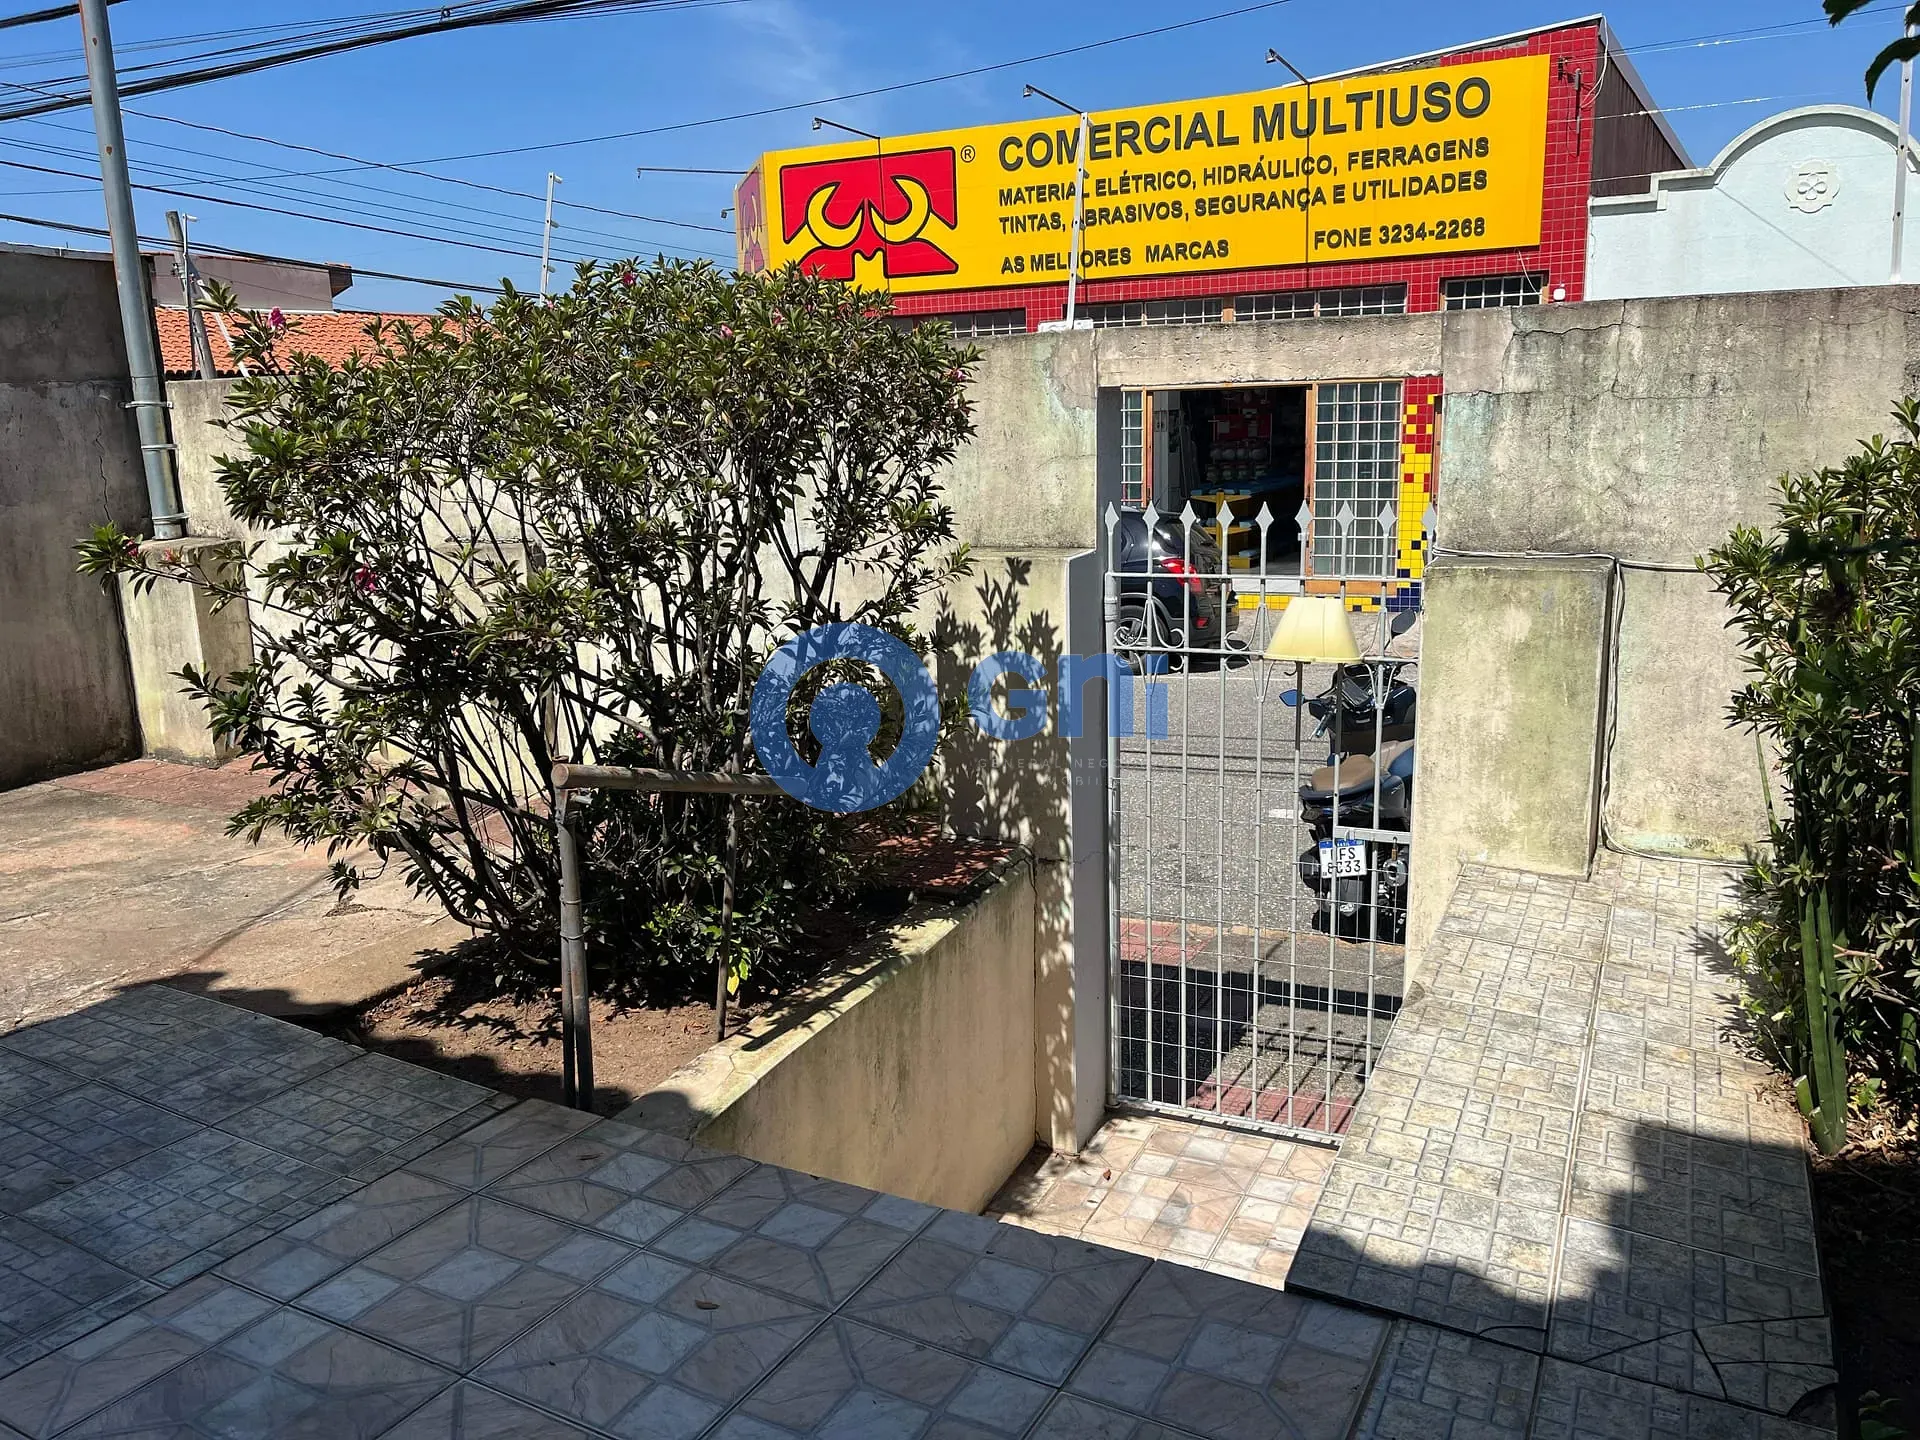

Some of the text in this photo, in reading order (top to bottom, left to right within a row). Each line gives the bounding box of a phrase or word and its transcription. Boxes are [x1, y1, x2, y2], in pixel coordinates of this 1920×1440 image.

[999, 77, 1491, 172] COMERCIAL MULTIUSO
[1095, 169, 1196, 197] ELÉTRICO,
[1203, 154, 1338, 187] HIDRÁULICO,
[1347, 137, 1489, 172] FERRAGENS
[999, 169, 1488, 234] TINTAS, BRASIVOS, SEGURANÇA E UTILIDADES
[1001, 256, 1025, 274] AS
[1145, 239, 1230, 263] MARCAS
[1314, 216, 1486, 250] FONE 3234-2268
